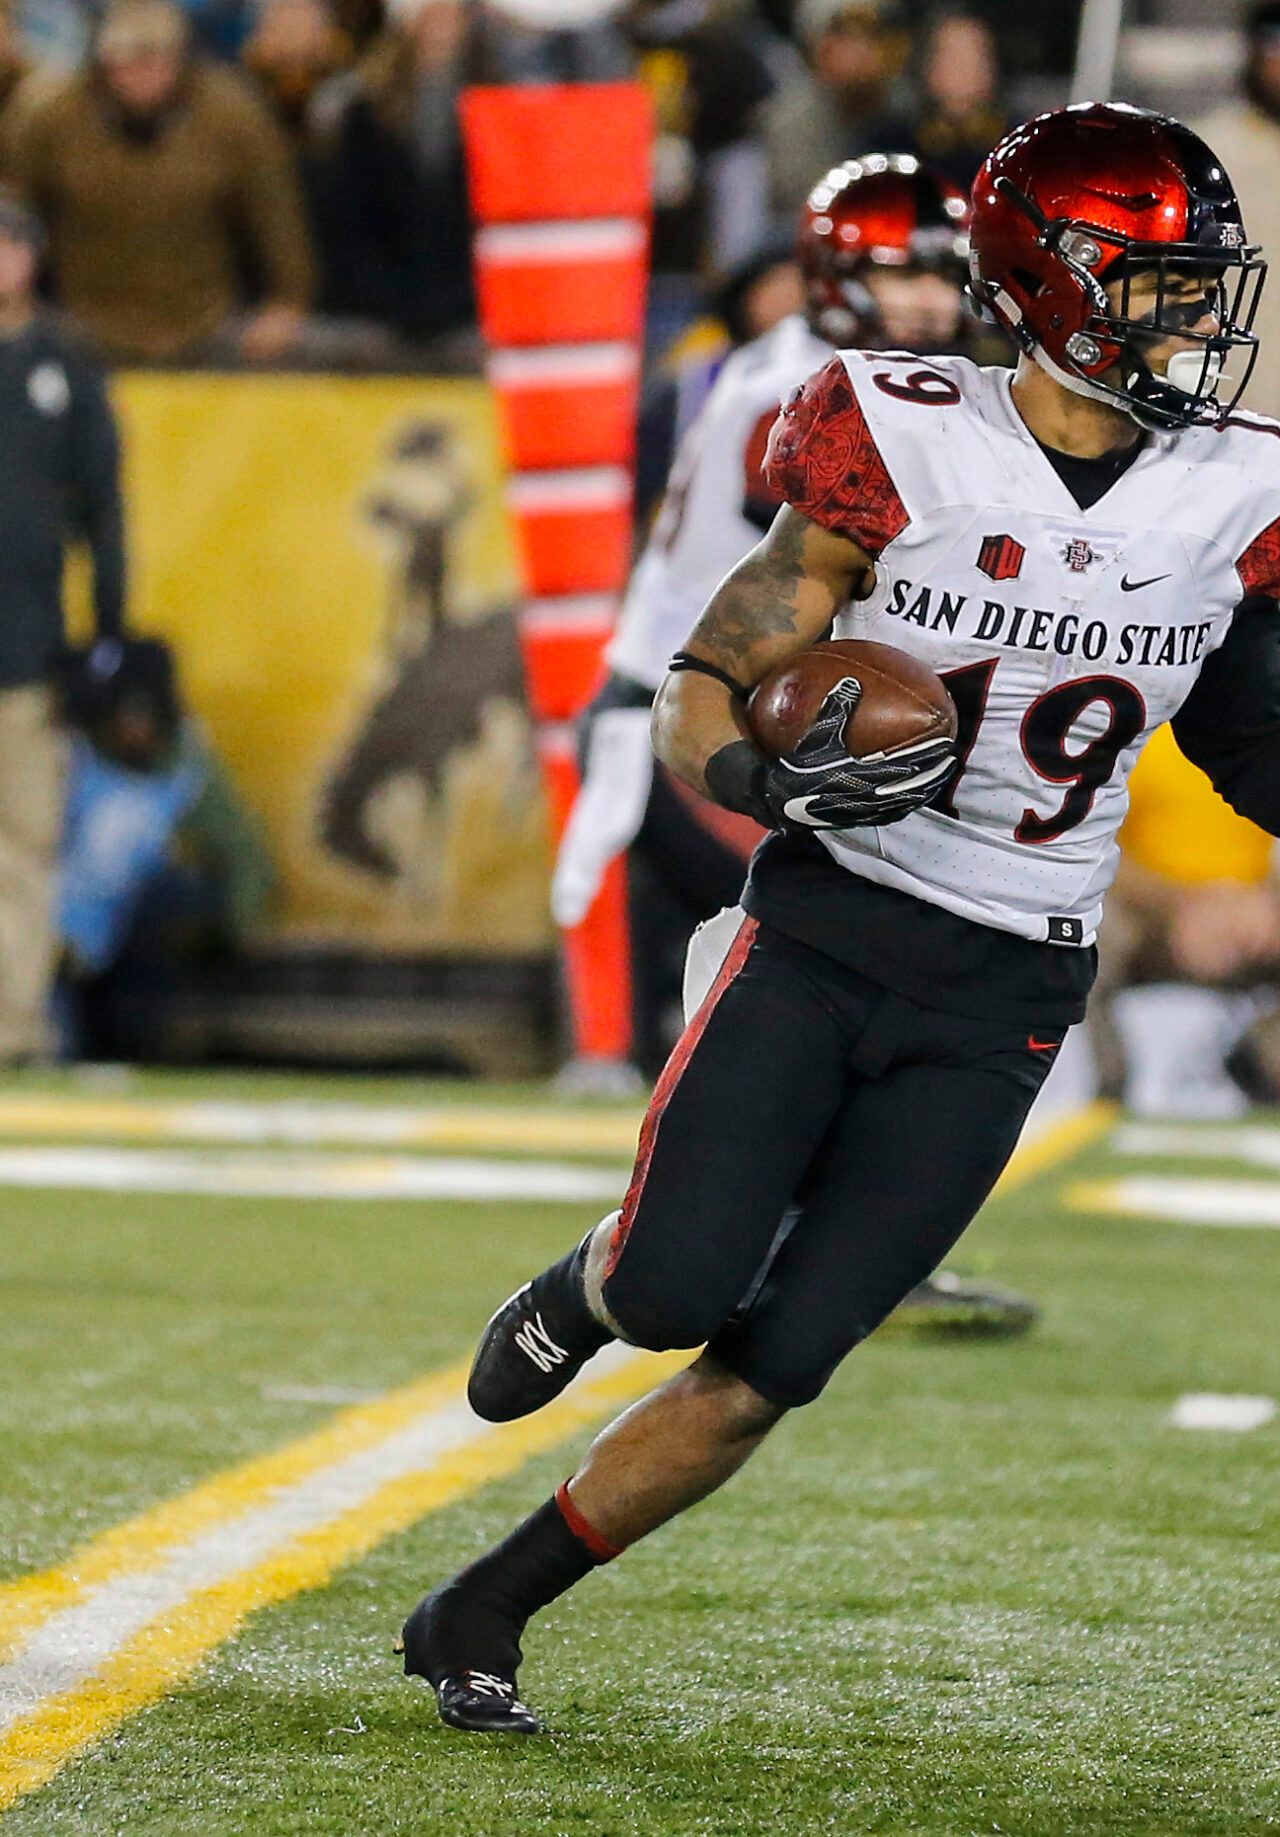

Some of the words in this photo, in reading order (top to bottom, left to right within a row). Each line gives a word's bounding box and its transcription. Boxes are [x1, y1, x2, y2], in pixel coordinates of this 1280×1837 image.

[885, 579, 968, 637] SAN
[972, 600, 1108, 661] DIEGO
[1115, 620, 1214, 667] STATE
[1061, 922, 1073, 937] S
